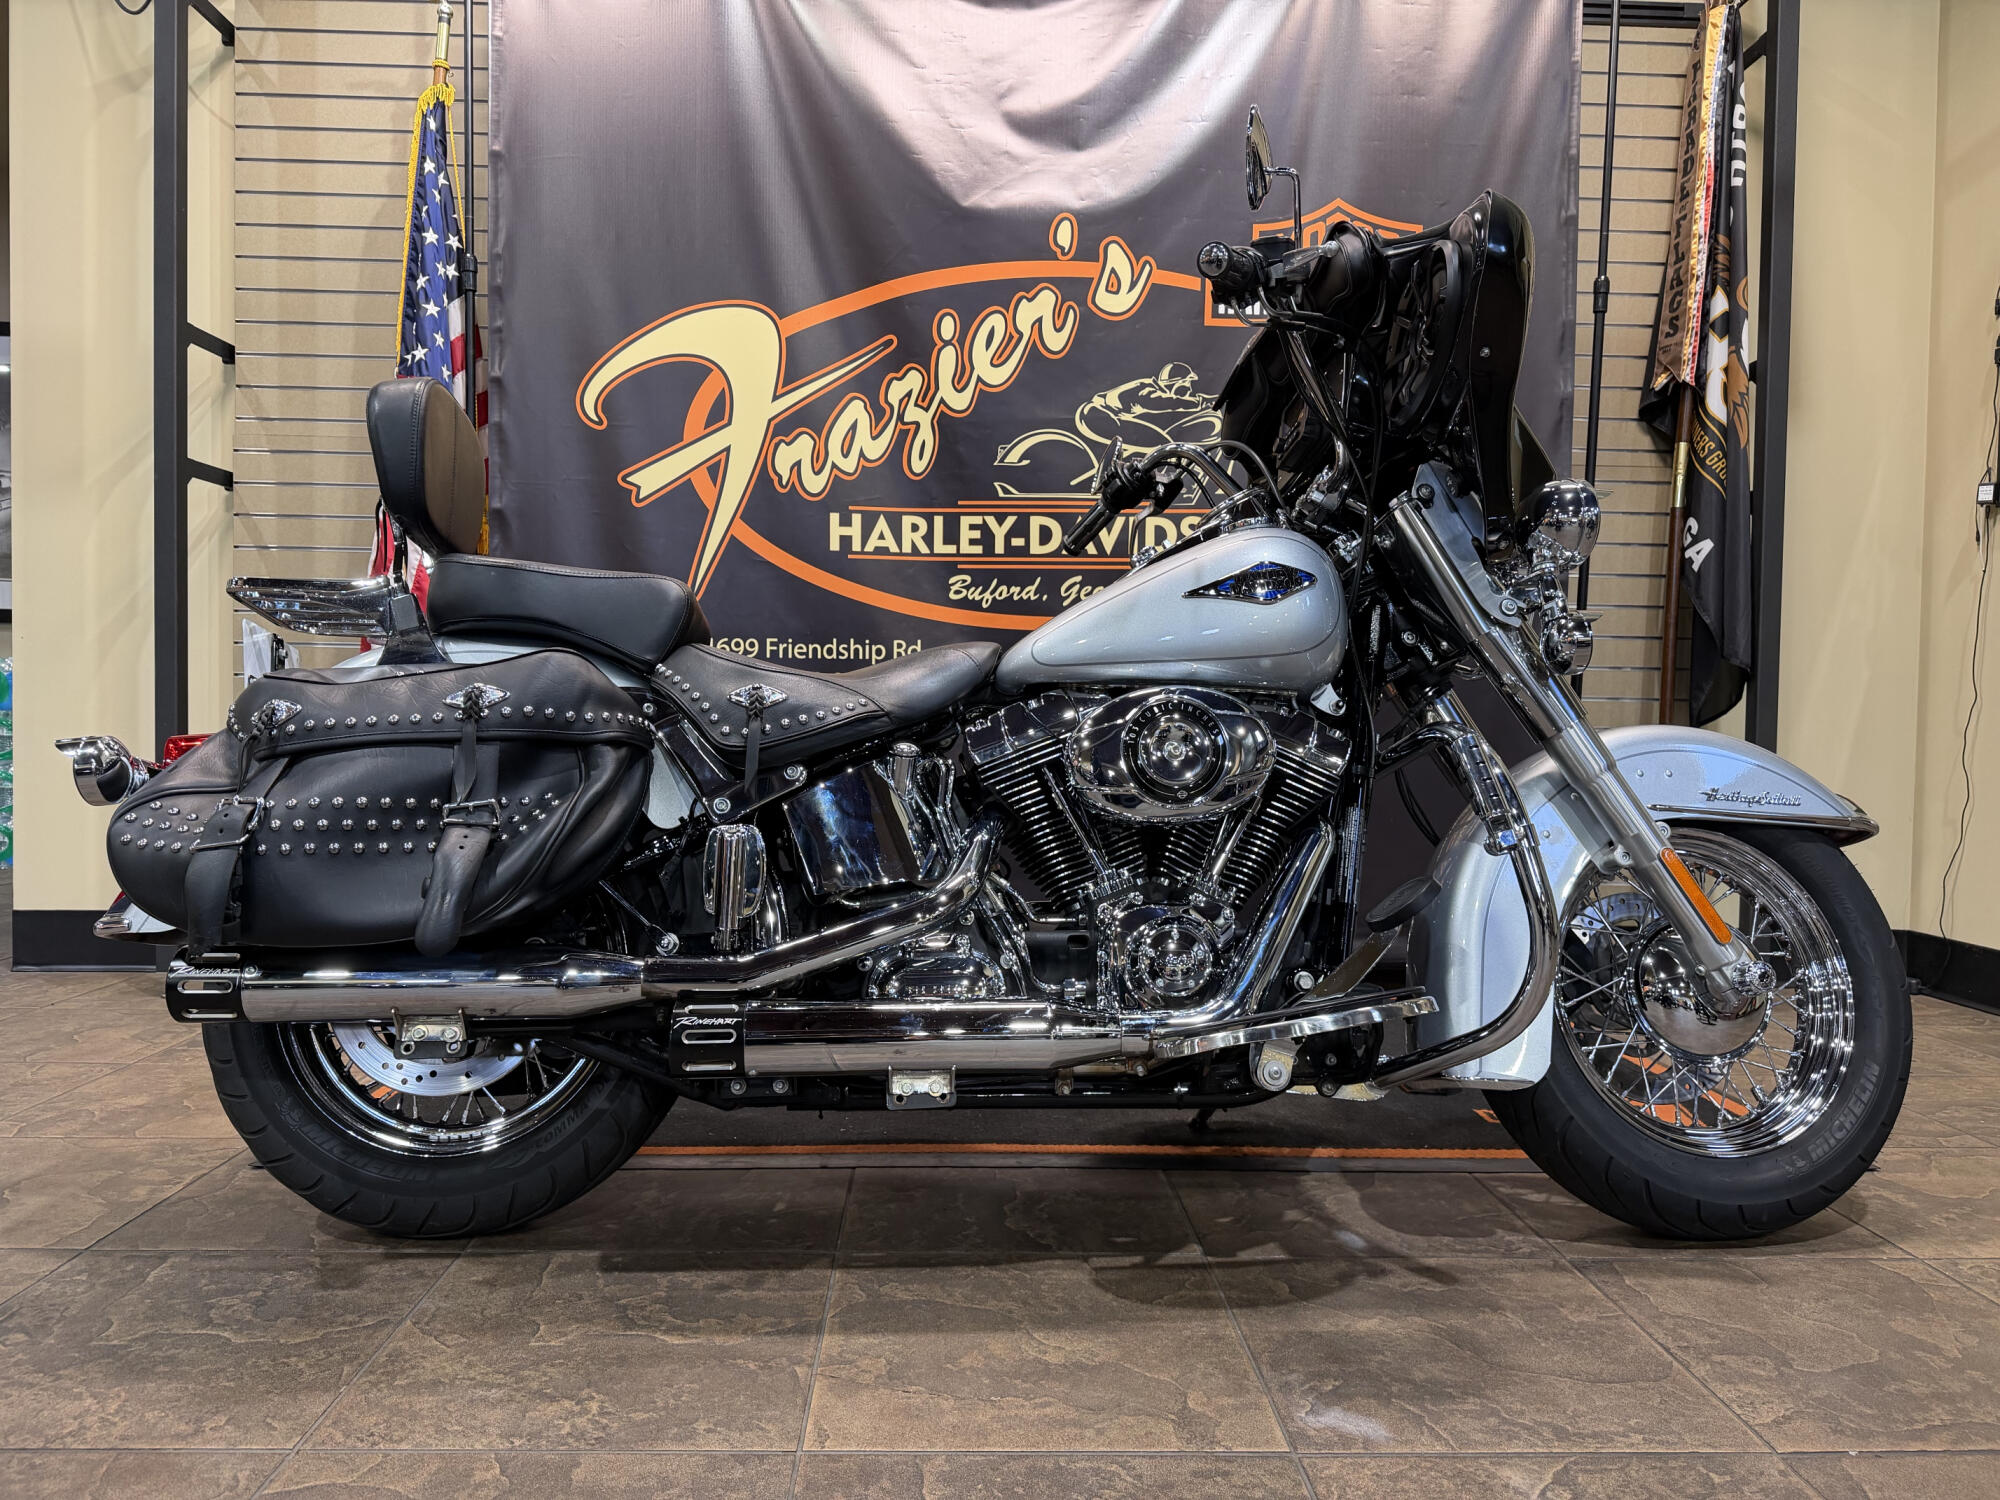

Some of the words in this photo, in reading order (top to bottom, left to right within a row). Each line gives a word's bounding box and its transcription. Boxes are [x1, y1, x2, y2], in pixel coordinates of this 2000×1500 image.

[1679, 60, 1701, 203] PARADE
[1664, 213, 1688, 339] FLAGS
[577, 213, 1156, 600] Frazier's
[829, 512, 1202, 556] HARLEY-DVIDS
[948, 574, 1048, 609] Buford,
[709, 637, 759, 658] 699
[765, 637, 886, 664] Friendship
[892, 638, 922, 657] Rd
[1127, 725, 1139, 744] 103
[1180, 702, 1220, 735] INCHES
[1807, 1060, 1880, 1161] MICHELIN
